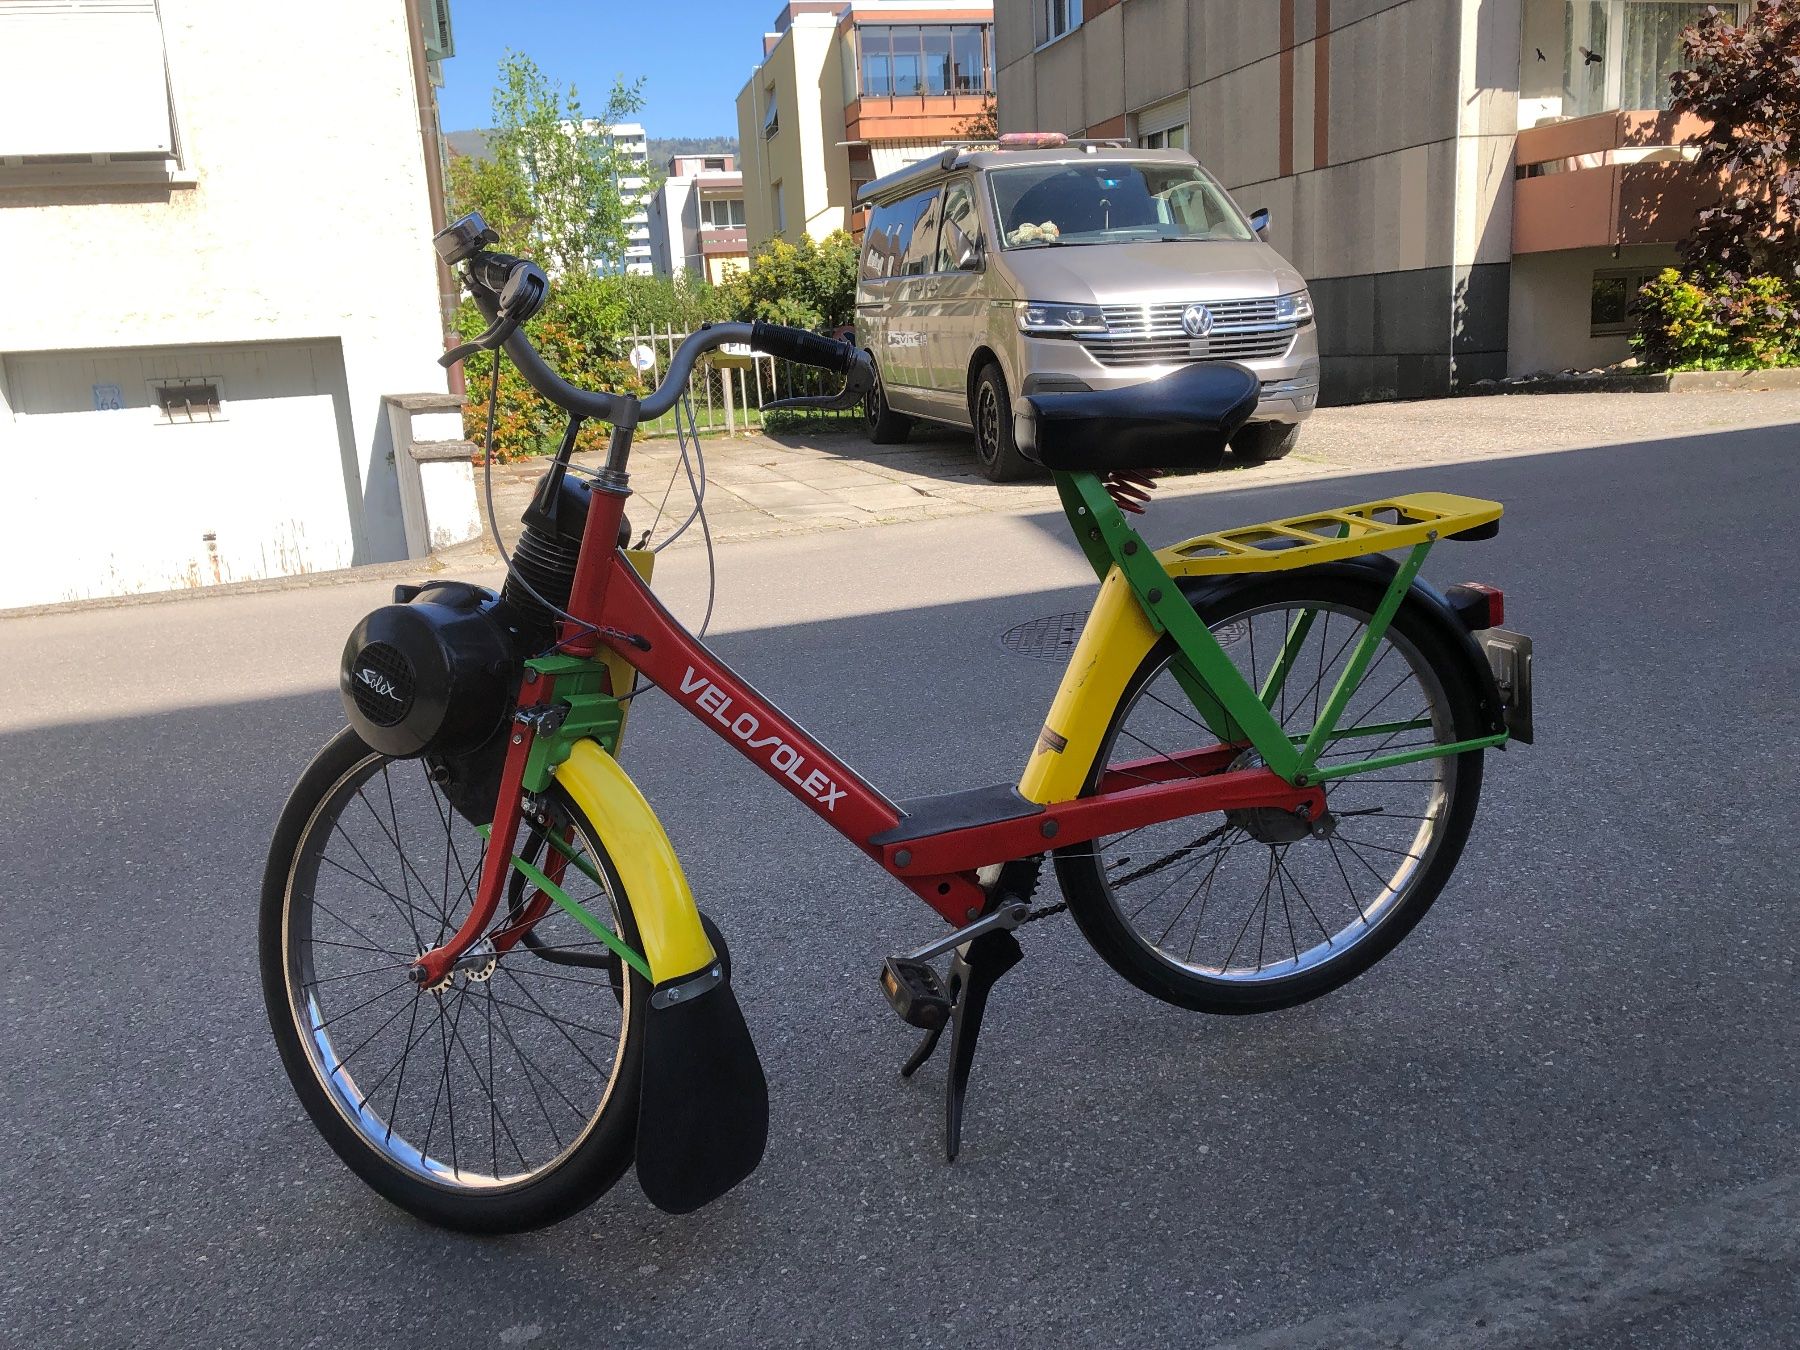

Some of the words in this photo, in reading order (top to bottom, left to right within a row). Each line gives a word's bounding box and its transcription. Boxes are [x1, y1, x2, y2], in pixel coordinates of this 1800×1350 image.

[101, 397, 119, 410] 66
[356, 668, 403, 702] Solex
[679, 665, 848, 812] VELOSOLEX
